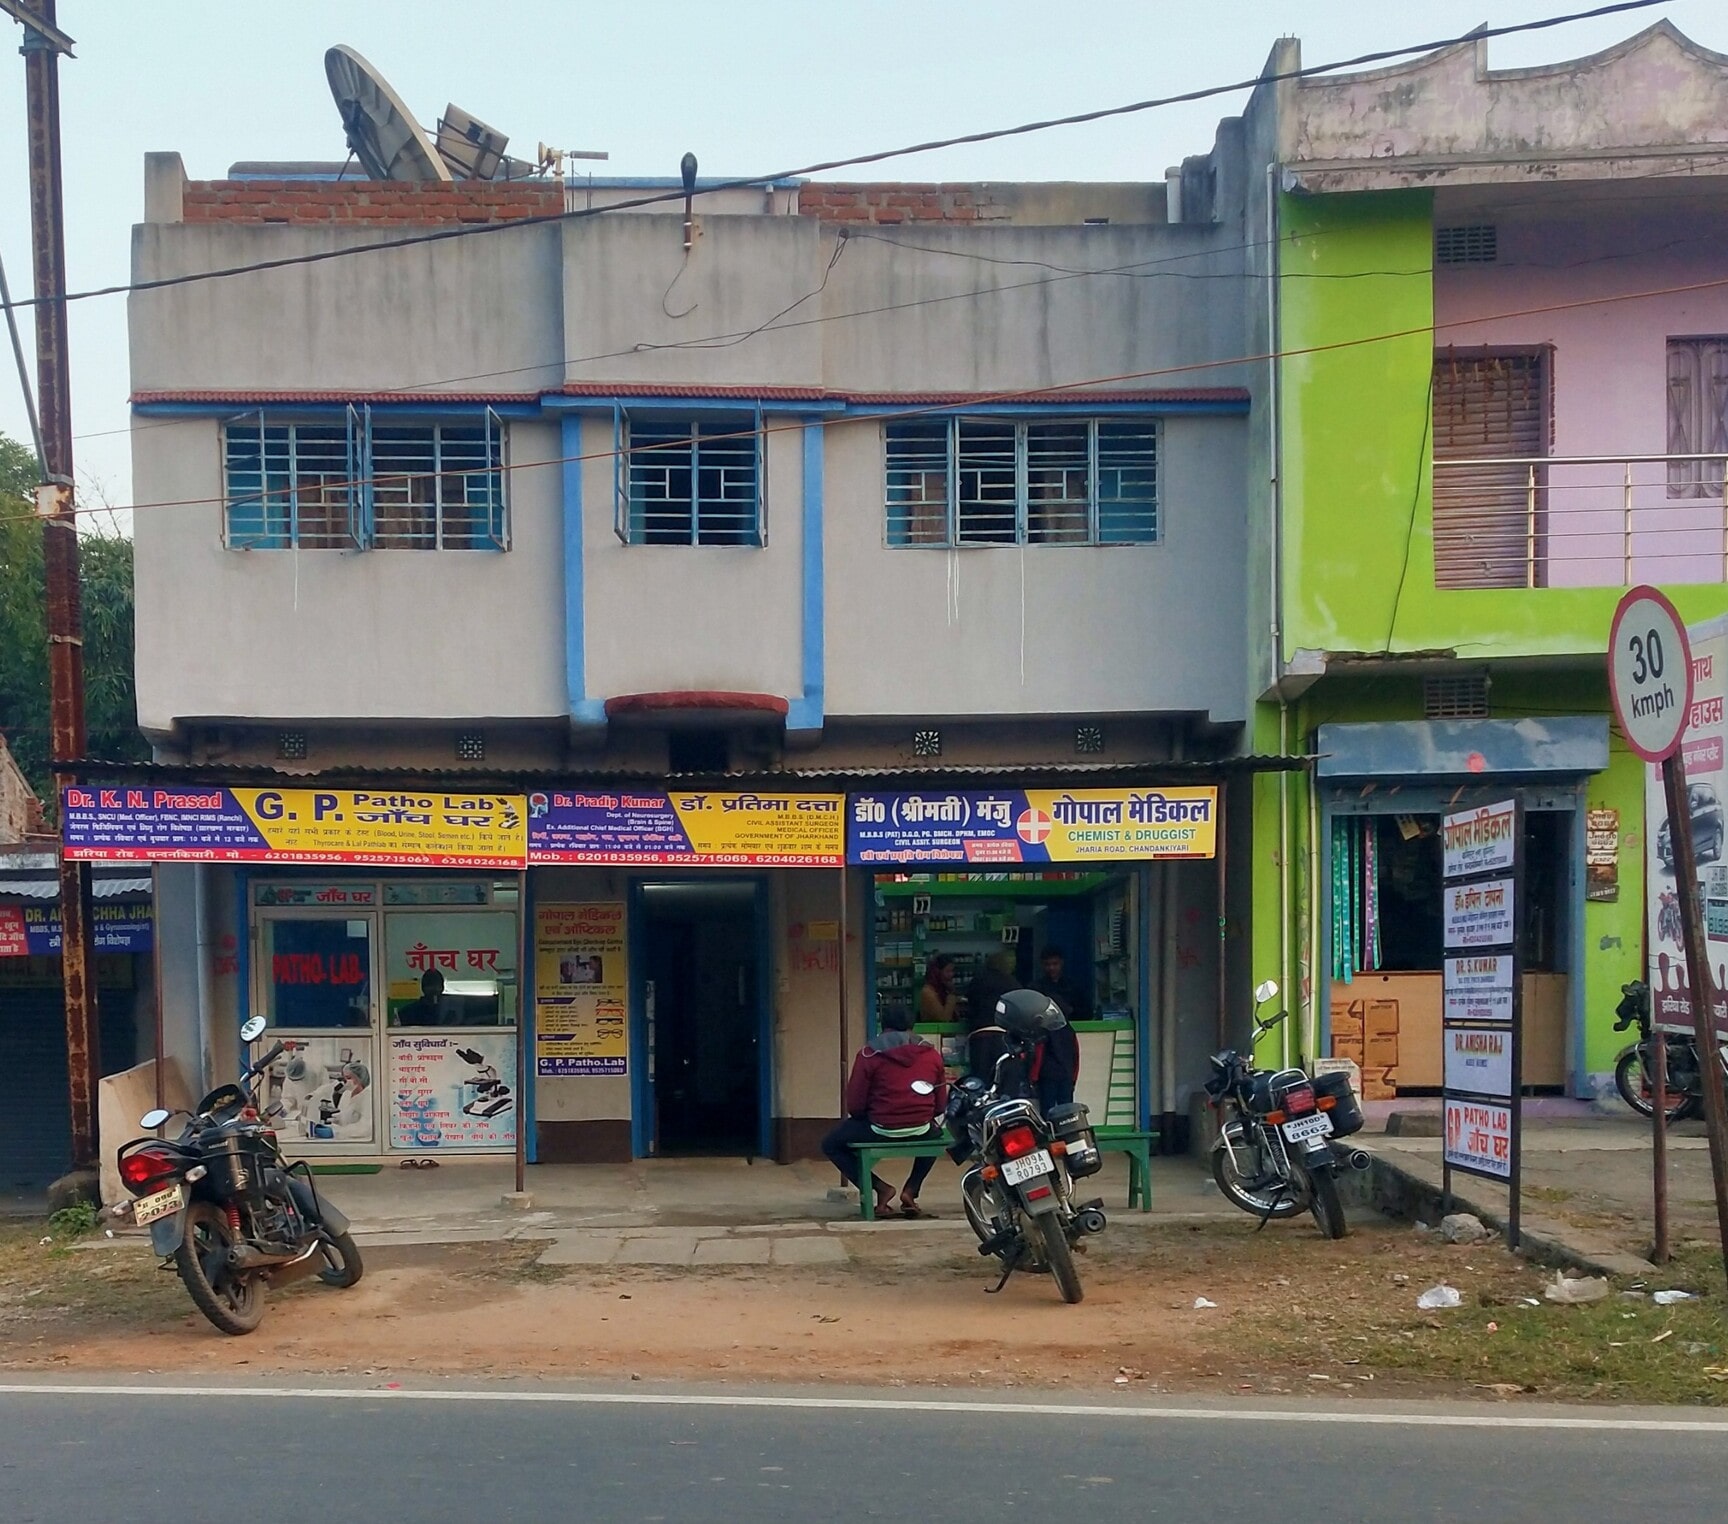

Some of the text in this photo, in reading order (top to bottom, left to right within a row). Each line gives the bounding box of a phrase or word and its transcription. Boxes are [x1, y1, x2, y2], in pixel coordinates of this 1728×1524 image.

[1629, 629, 1663, 684] 30
[1631, 683, 1674, 718] kmph
[68, 789, 222, 808] Dr. K. N. Prasad
[254, 792, 494, 821] G. P. Patho Lab
[554, 795, 665, 809] Dr. Pradip Kumar
[680, 794, 838, 814] डॉ. प्रतिमा दत्ता
[891, 796, 971, 827] (श्रीमती)
[976, 796, 1012, 828] मंजु
[1053, 793, 1211, 824] गोपाल मेडिकल
[217, 815, 242, 823] (Ranchi)
[353, 809, 494, 827] जाँच घर
[885, 831, 900, 839] (PAT)
[1068, 829, 1196, 841] CHEMIST & DRUGGIST
[1444, 808, 1513, 850] गोपाल मेडिकल
[115, 834, 133, 842] रविवार
[73, 850, 107, 859] झरिया
[441, 857, 518, 866] 6204026168
[577, 853, 663, 863] 6201835956,
[667, 855, 752, 863] 9525715069,
[756, 855, 837, 863] 6204026168
[351, 891, 371, 903] घर
[26, 908, 46, 922] DR.
[539, 908, 622, 920] गोपाल मेडिकल
[405, 942, 501, 974] जाँच घर
[1293, 1116, 1320, 1129] JH10D
[1464, 1107, 1489, 1127] PATHO
[1492, 1111, 1507, 1131] LAB
[1292, 1124, 1329, 1140] 8662
[1493, 1135, 1509, 1159] घर
[1015, 1153, 1044, 1170] JH09A
[1017, 1163, 1048, 1180] R0793
